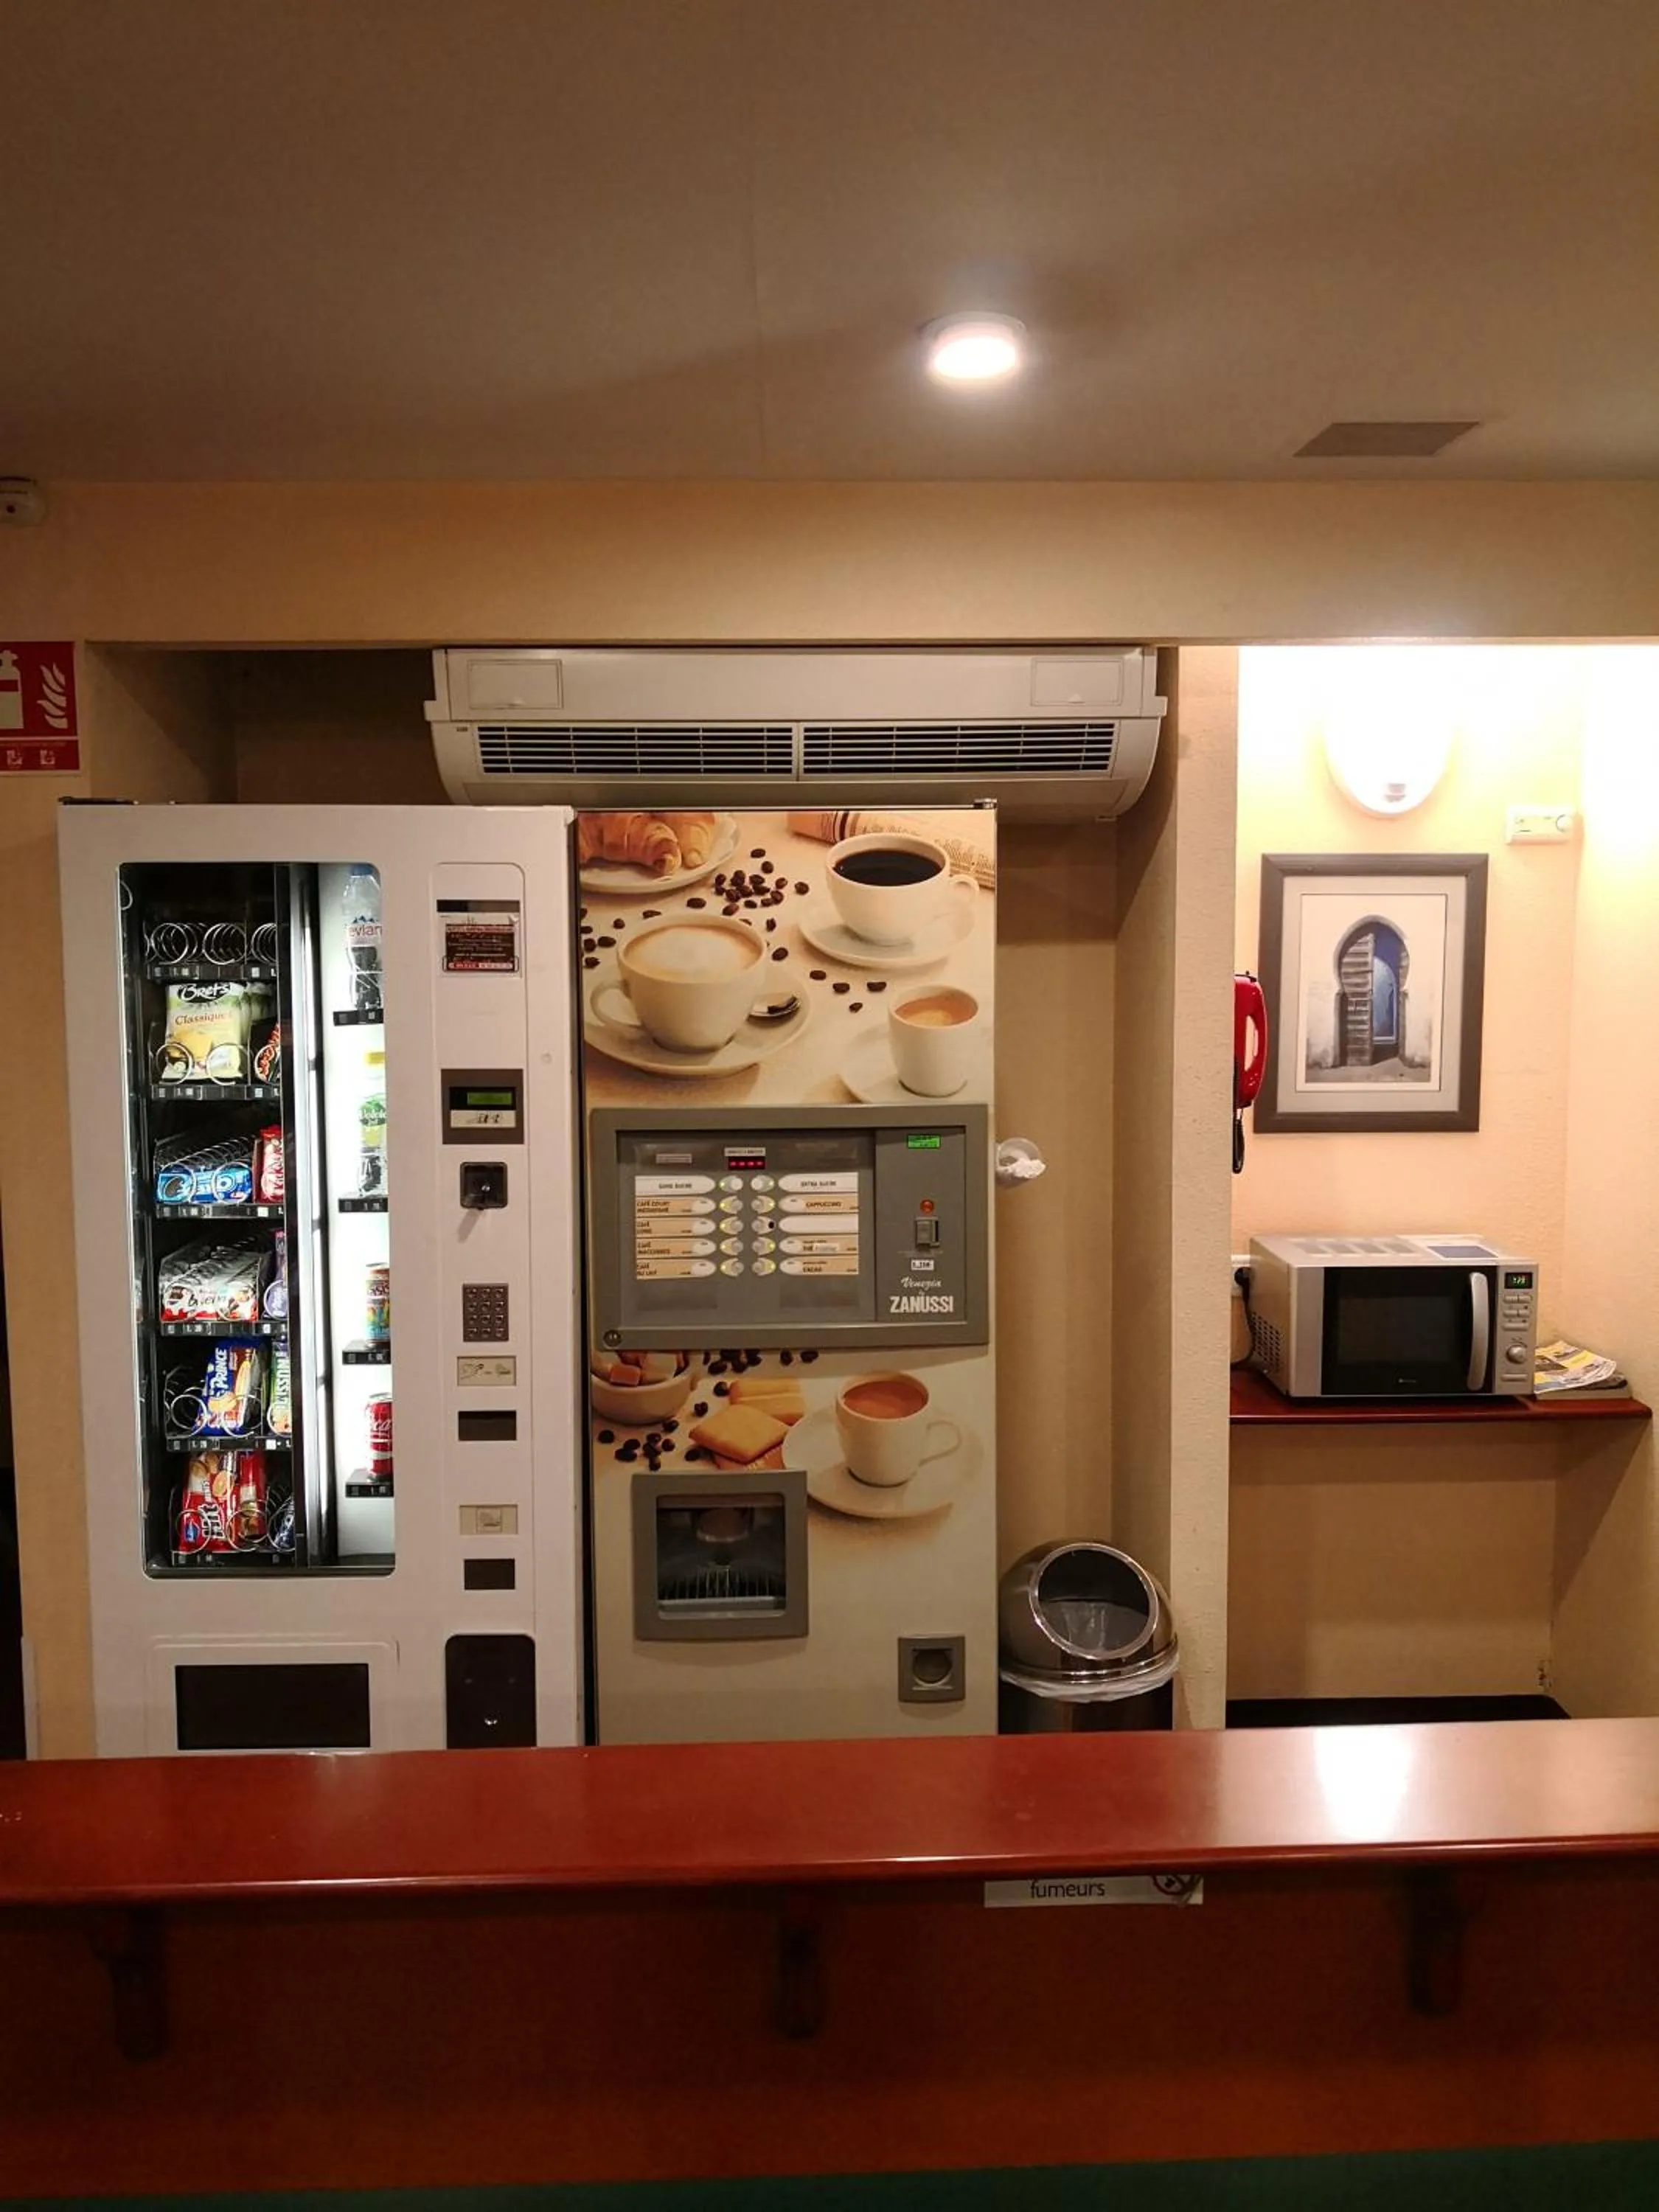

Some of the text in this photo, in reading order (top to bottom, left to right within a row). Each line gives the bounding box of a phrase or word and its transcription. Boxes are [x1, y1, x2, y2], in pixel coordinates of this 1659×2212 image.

[889, 1295, 954, 1313] ZANUSSI
[211, 1348, 229, 1389] PRINCE
[1031, 1880, 1105, 1899] fumeurs
